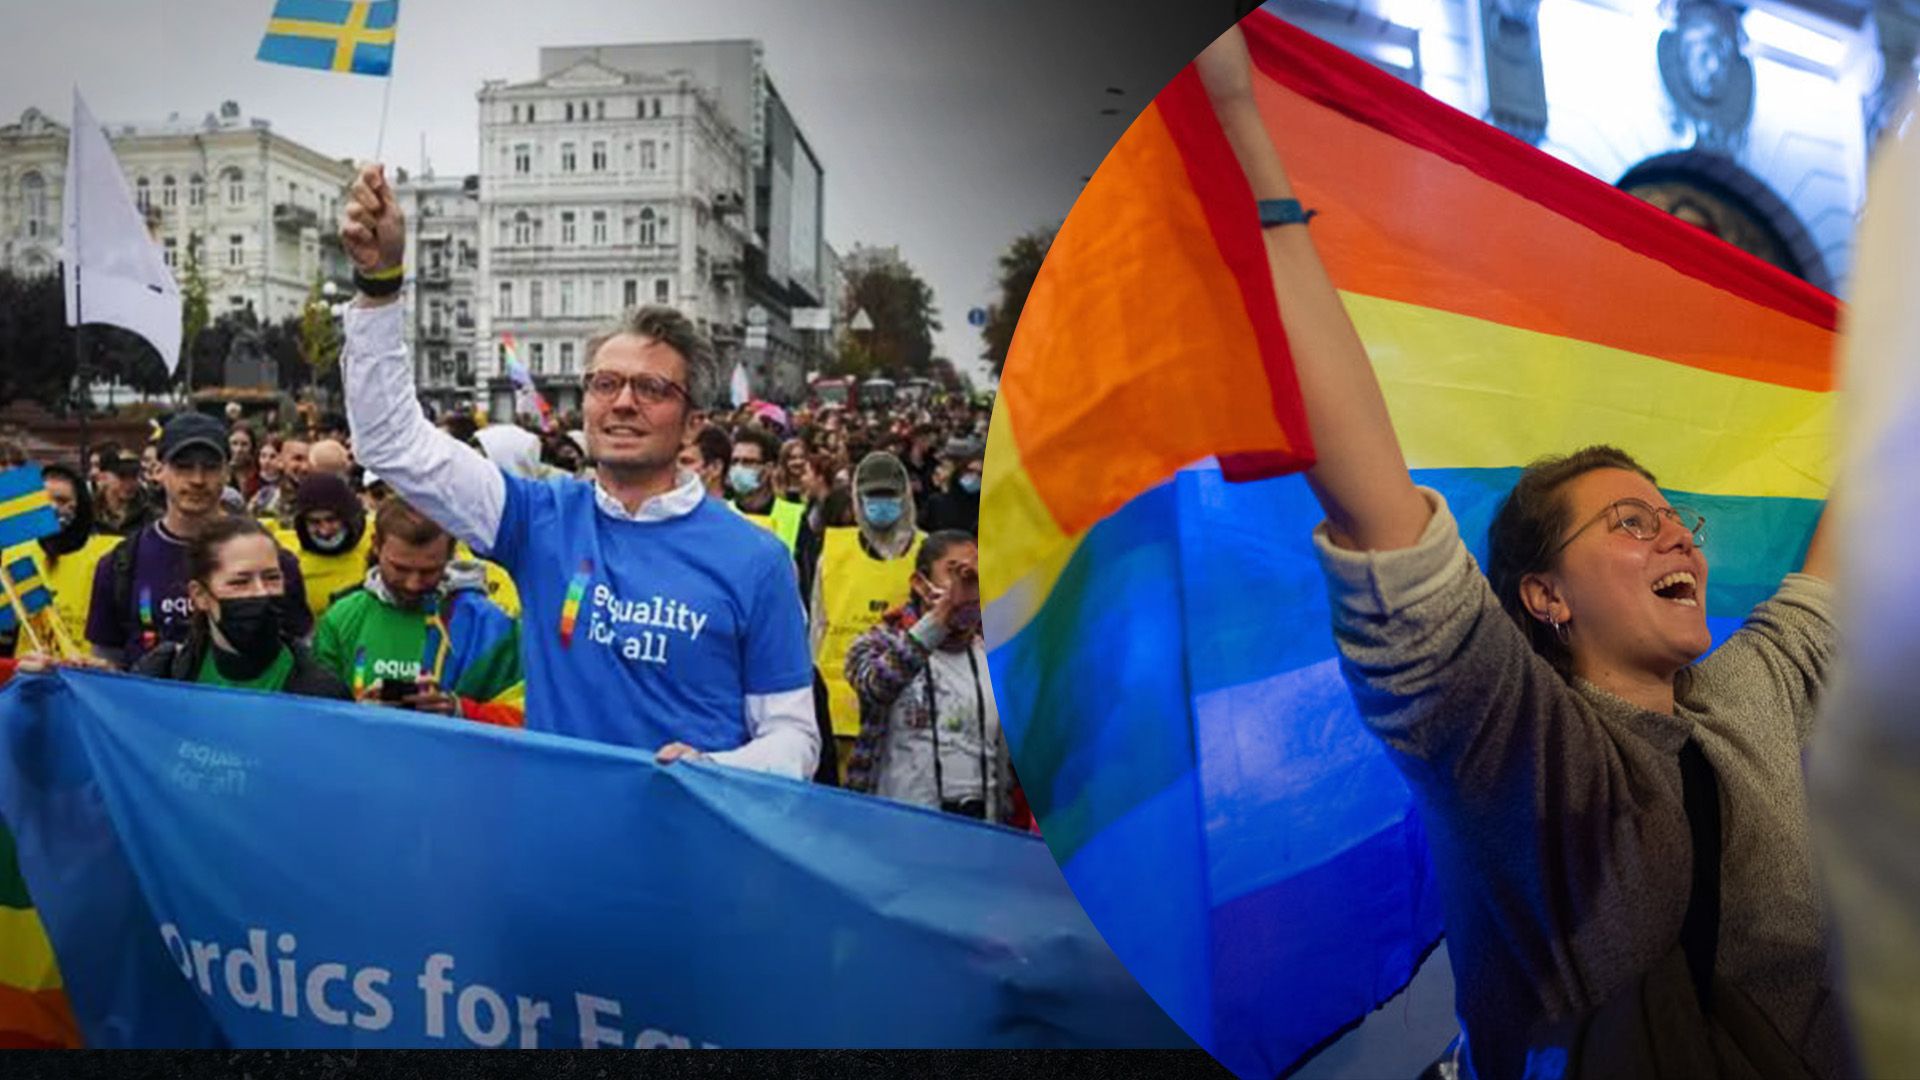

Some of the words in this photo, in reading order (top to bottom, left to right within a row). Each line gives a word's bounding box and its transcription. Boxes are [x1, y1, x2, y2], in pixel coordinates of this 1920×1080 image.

[593, 583, 708, 640] equality
[622, 630, 667, 664] all
[417, 952, 552, 1049] for
